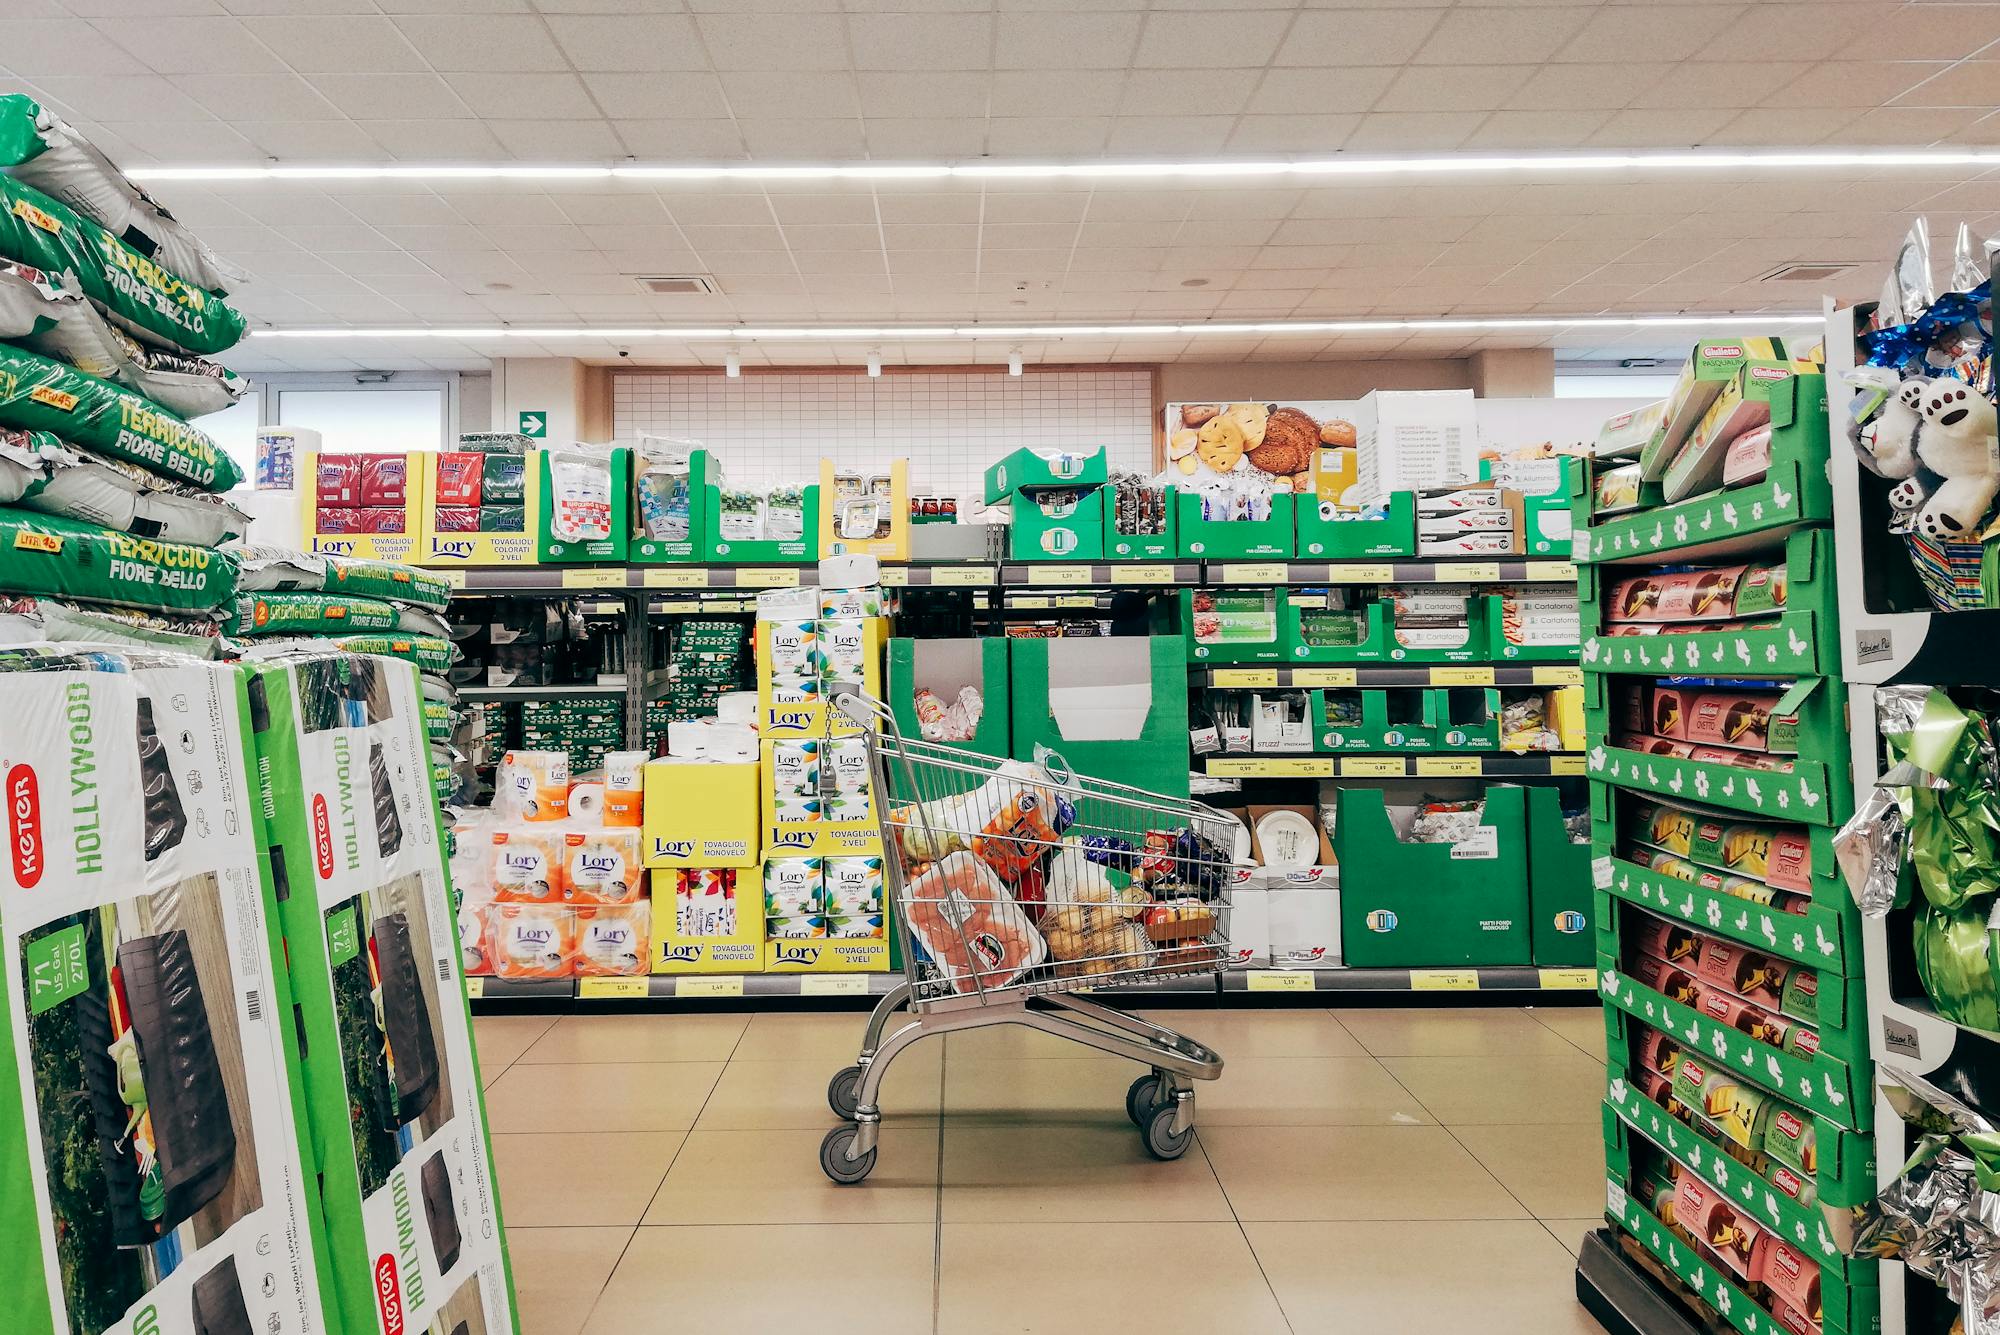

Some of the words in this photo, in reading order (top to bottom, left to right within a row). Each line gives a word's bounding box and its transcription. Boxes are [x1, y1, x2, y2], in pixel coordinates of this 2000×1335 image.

[104, 264, 151, 305] FIORE
[154, 294, 205, 334] BELLO
[58, 394, 72, 407] 45
[118, 398, 216, 466] TERRICCIO
[115, 429, 163, 465] FIORE
[167, 452, 215, 486] BELLO
[441, 461, 465, 473] Lory
[380, 463, 404, 473] Lory
[321, 518, 346, 531] Lory
[377, 521, 401, 532] Lory
[42, 537, 57, 550] 45
[102, 531, 209, 569] TERRICCIO
[312, 537, 356, 557] Lory
[430, 537, 476, 559] Lory
[109, 559, 154, 584] FIORE
[158, 568, 207, 591] BELLO
[257, 608, 266, 619] 2
[350, 615, 370, 627] FIORE
[371, 616, 392, 628] BELLO
[775, 636, 801, 647] Lory
[833, 635, 860, 647] Lory
[777, 694, 802, 702] Lory
[767, 709, 815, 730] Lory
[1697, 721, 1715, 730] OVETTO
[777, 754, 802, 767] Lory
[839, 755, 865, 767] Lory
[66, 682, 102, 875] HOLLYWOOD
[258, 755, 276, 819] HOLLYWOOD
[516, 776, 531, 790] ory
[611, 775, 632, 785] Lory
[334, 736, 360, 870] HOLLYWOOD
[16, 776, 37, 875] KETER
[315, 803, 331, 870] KETER
[769, 828, 818, 851] Lory
[652, 838, 696, 859] Lory
[506, 853, 540, 870] Lory
[579, 854, 618, 871] Lory
[1777, 863, 1800, 876] OVETTO
[780, 872, 805, 884] Lory
[841, 871, 866, 883] Lory
[705, 913, 716, 934] Lory
[333, 930, 346, 953] 71
[517, 926, 553, 943] Lory
[593, 926, 630, 944] Lory
[784, 930, 810, 938] Lory
[844, 930, 871, 938] Lory
[51, 945, 62, 970] Gal
[69, 933, 84, 982] 270L
[660, 942, 704, 963] Lory
[771, 943, 822, 966] Lory
[34, 960, 52, 995] 71
[54, 972, 63, 995] US
[1681, 1201, 1699, 1221] OVETTO
[392, 1171, 426, 1313] HOLLYWOOD
[1773, 1267, 1796, 1291] OVETTO
